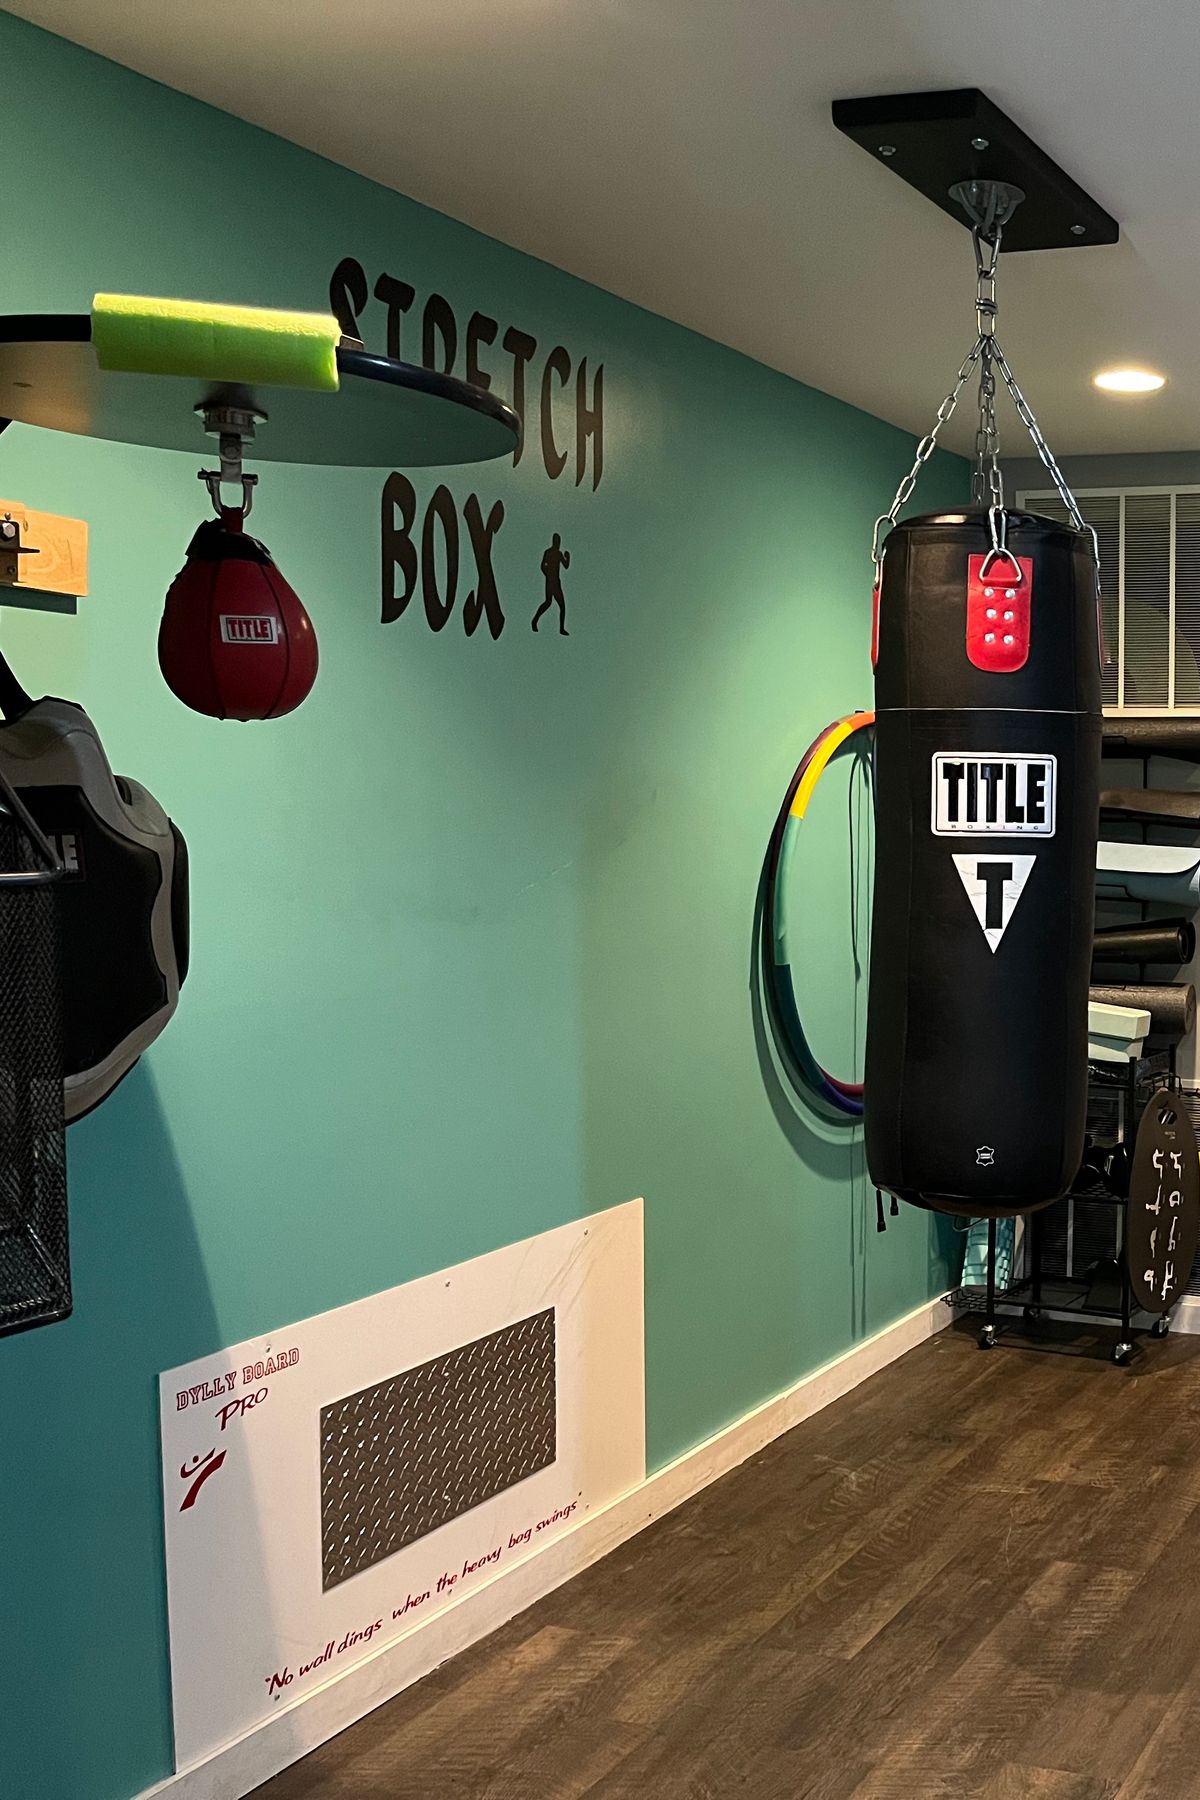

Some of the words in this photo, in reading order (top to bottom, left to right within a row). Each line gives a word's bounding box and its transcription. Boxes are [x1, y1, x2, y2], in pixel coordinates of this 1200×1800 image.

[380, 471, 505, 640] BOX
[228, 619, 270, 638] TITLE
[943, 763, 1045, 824] TITLE
[977, 862, 1012, 929] T
[176, 1371, 237, 1411] DYLLY
[242, 1347, 300, 1385] BOARD
[215, 1387, 269, 1432] PRO
[299, 1641, 335, 1677] wall
[337, 1618, 383, 1655] dings
[392, 1590, 431, 1620] when
[436, 1573, 458, 1593] the
[462, 1546, 502, 1578] heavy
[508, 1528, 532, 1549] bag
